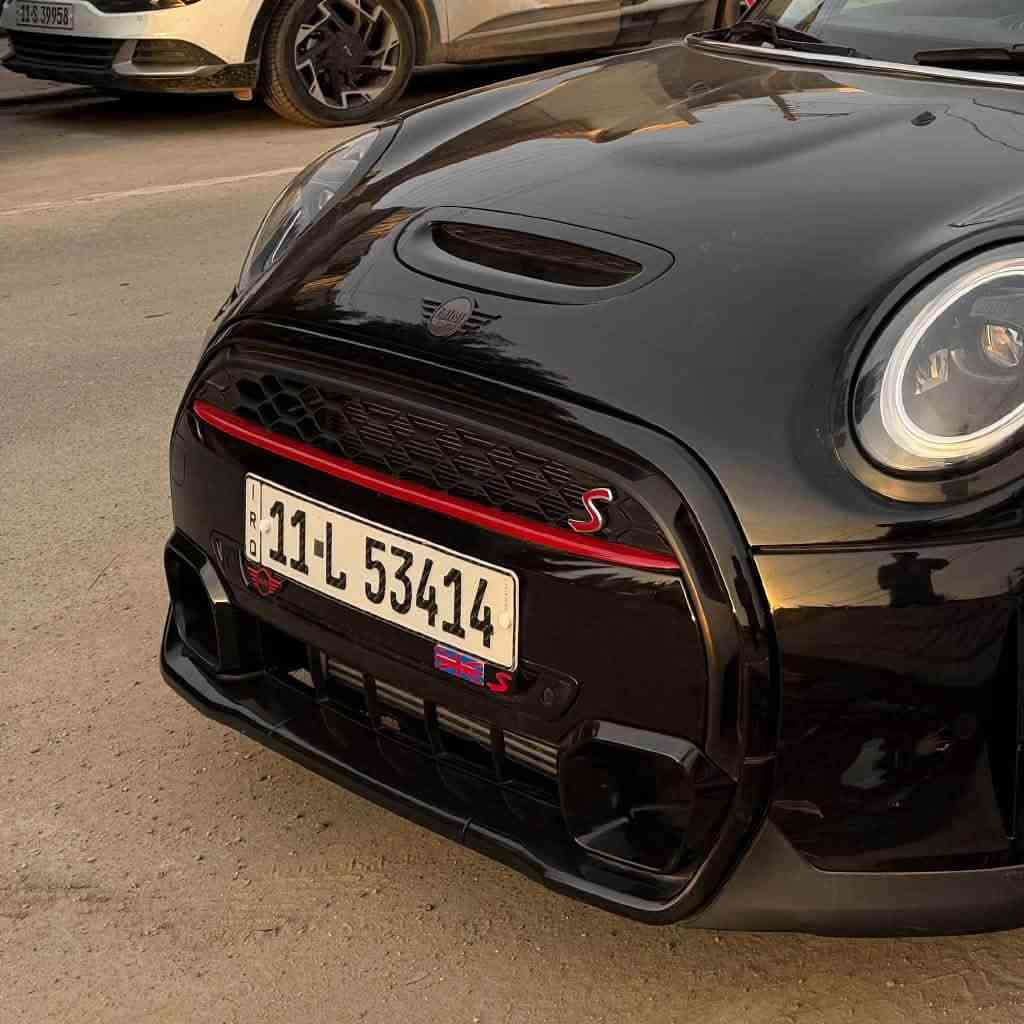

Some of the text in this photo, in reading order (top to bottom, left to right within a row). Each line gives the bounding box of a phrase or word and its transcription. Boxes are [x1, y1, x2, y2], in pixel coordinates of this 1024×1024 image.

[40, 5, 70, 25] 39958
[567, 487, 613, 534] S
[364, 536, 495, 649] 53414
